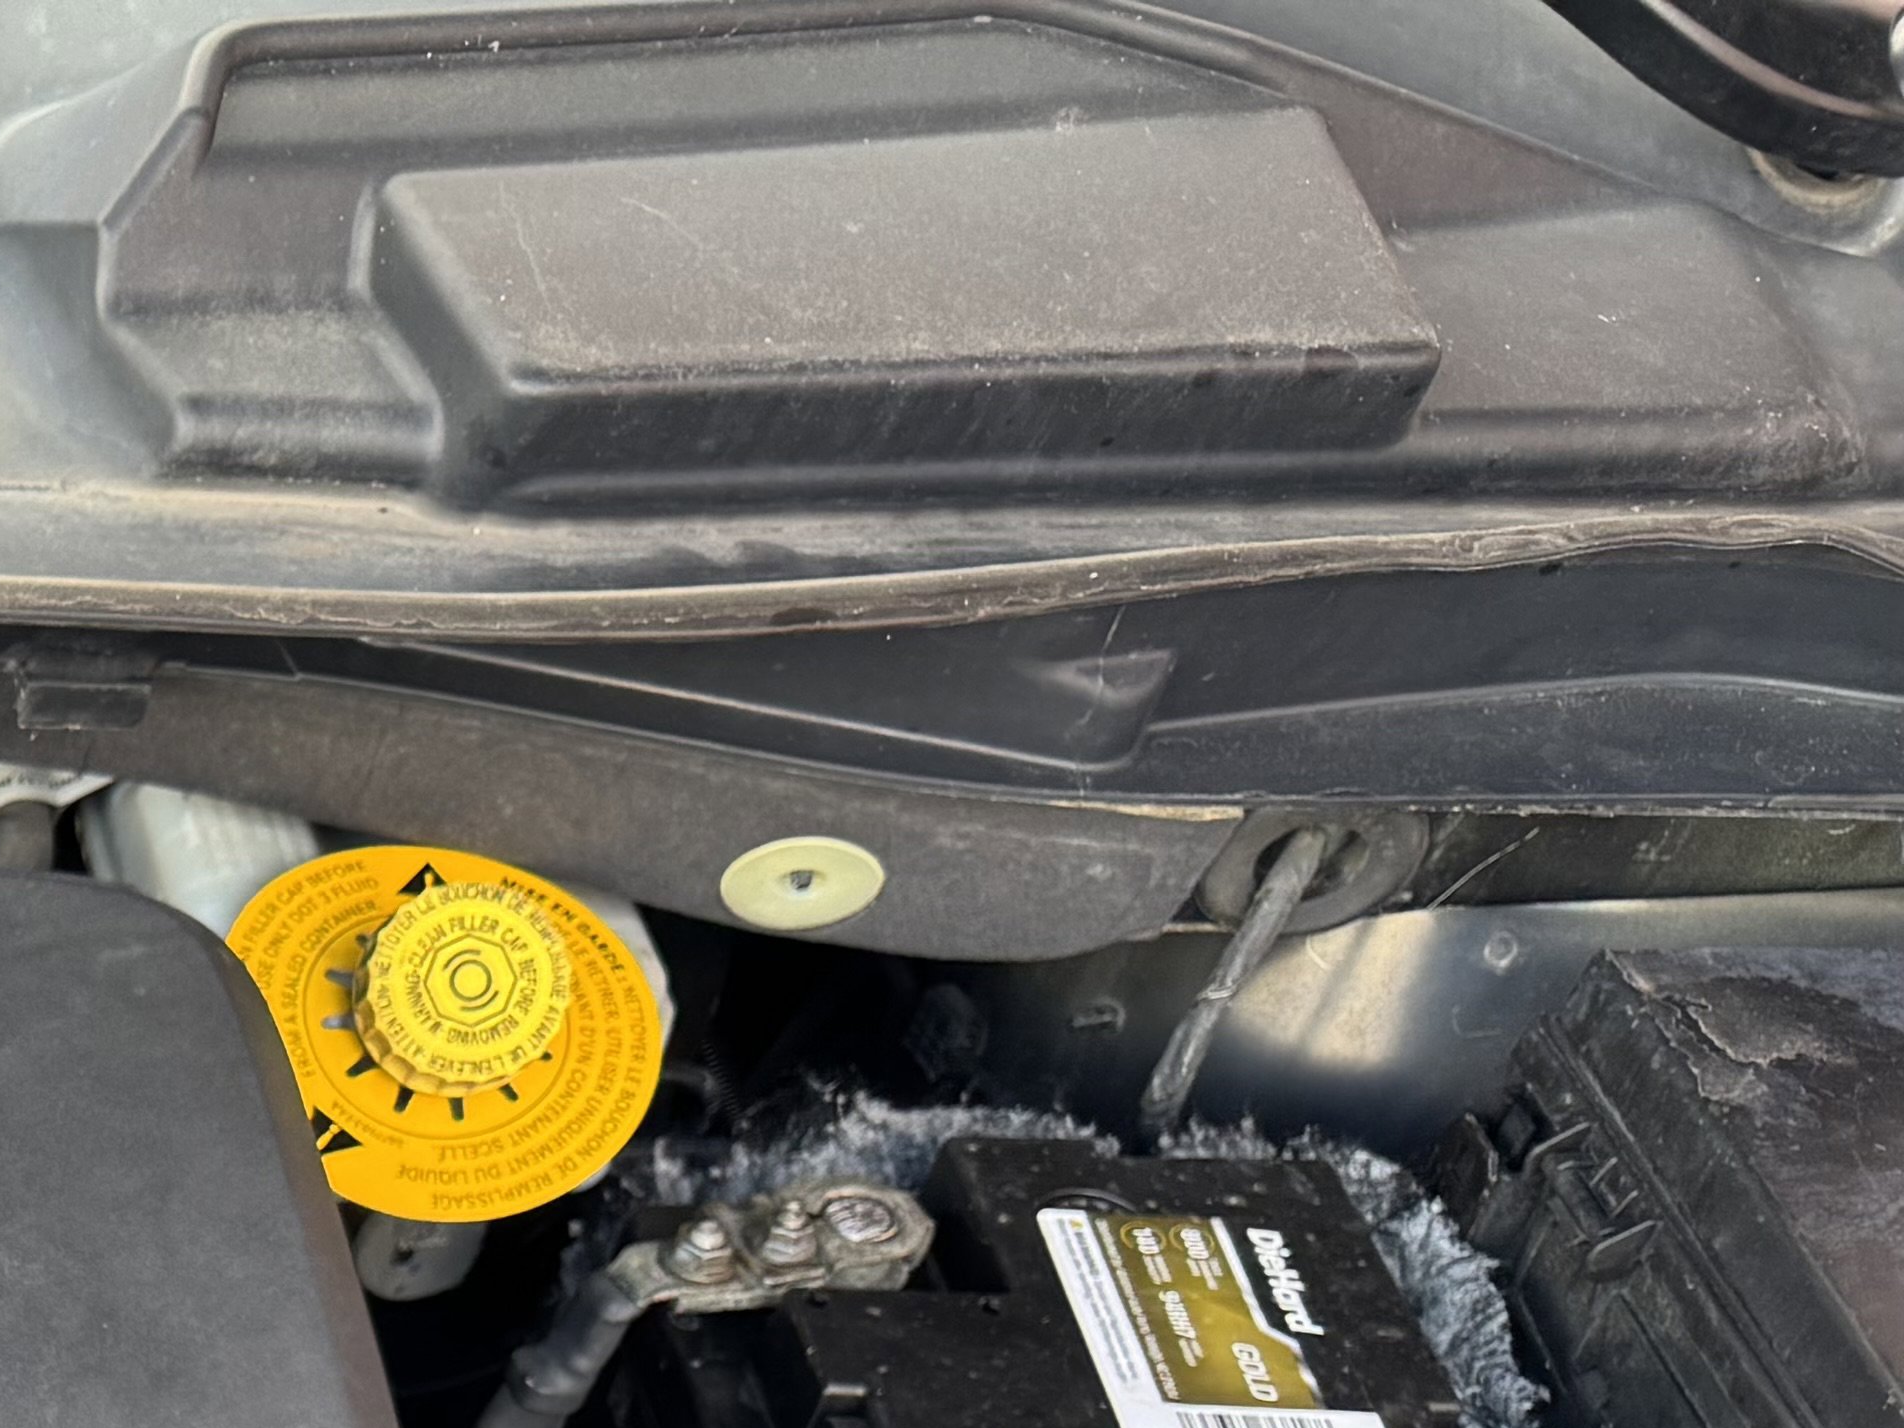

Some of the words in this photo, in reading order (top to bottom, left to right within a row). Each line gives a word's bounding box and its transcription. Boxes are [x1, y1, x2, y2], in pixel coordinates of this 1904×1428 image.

[276, 880, 303, 906] CAP
[288, 898, 318, 924] DOT
[330, 877, 379, 899] FLUID
[448, 914, 500, 934] FILLER
[578, 1087, 638, 1161] BOUCHON
[397, 1163, 470, 1186] LIQUIDE
[431, 1172, 554, 1211] REMPLISSAGE
[1245, 1226, 1324, 1336] DieHard
[1230, 1341, 1279, 1402] GOLD
